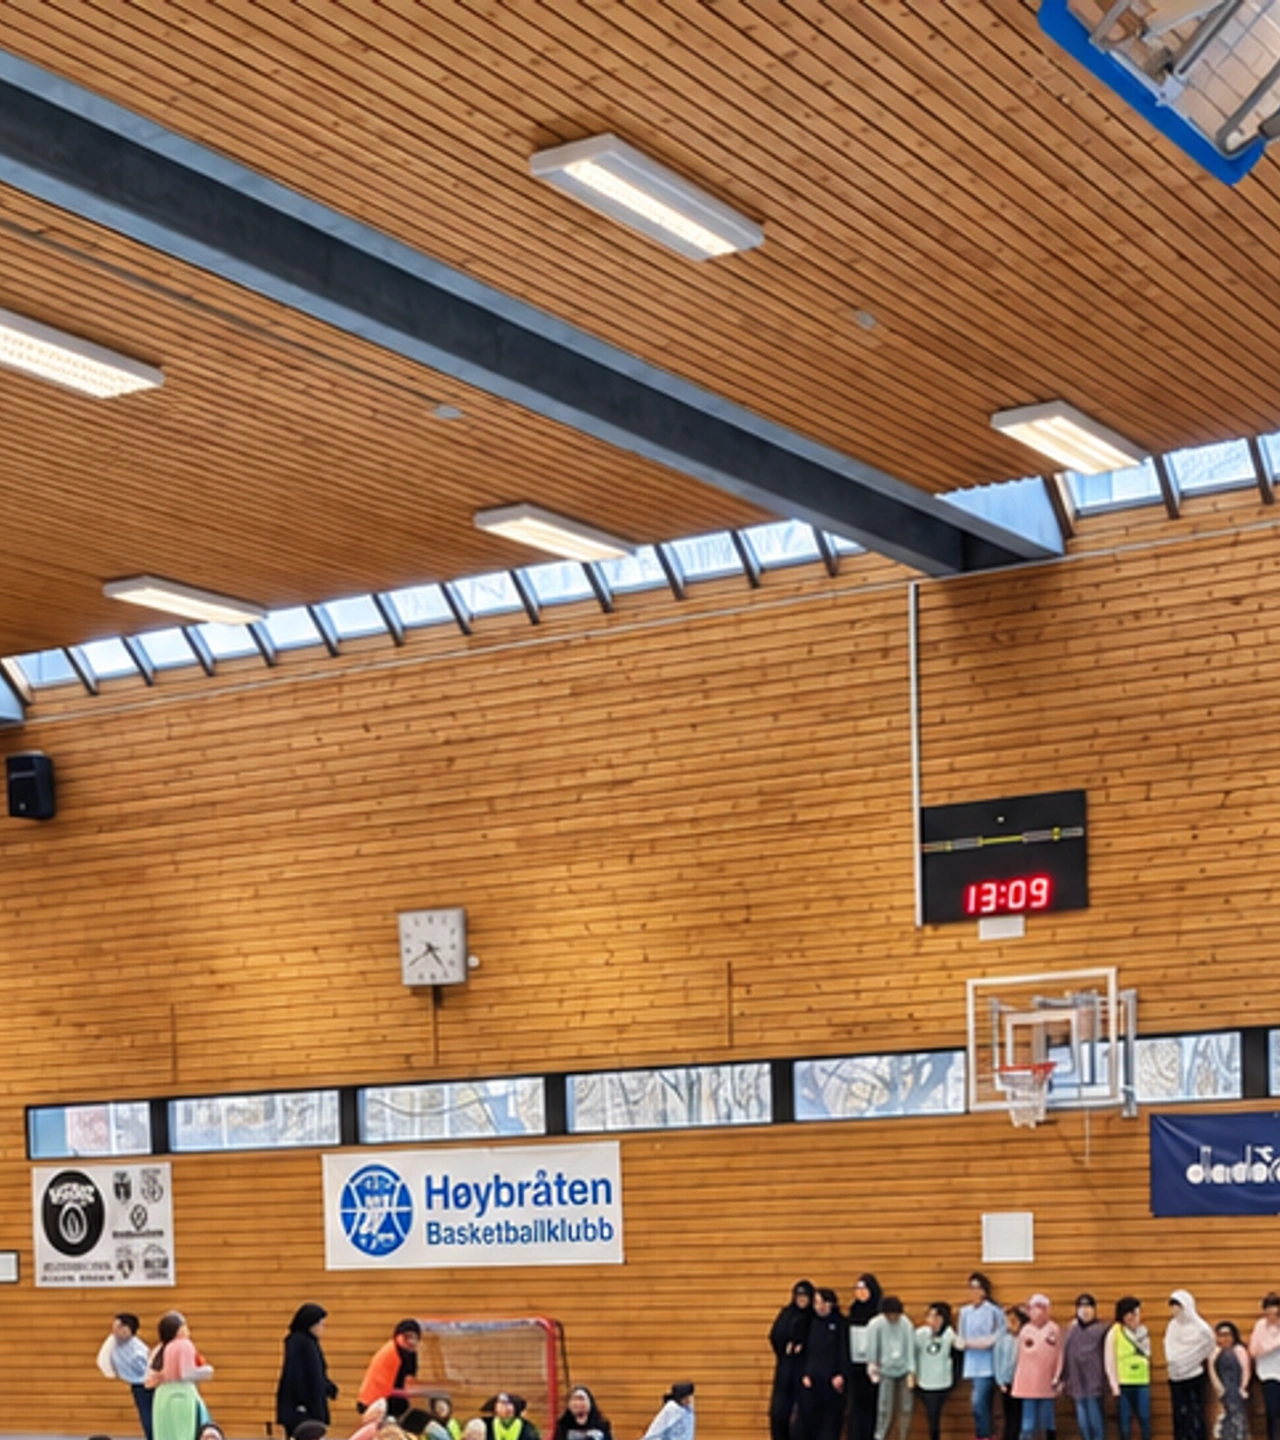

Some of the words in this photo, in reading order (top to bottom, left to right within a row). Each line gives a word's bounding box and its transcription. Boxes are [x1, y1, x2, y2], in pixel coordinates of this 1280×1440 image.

[967, 877, 1049, 914] 13:09
[424, 1168, 614, 1218] Høybråten
[426, 1216, 615, 1246] Basketballklubb
